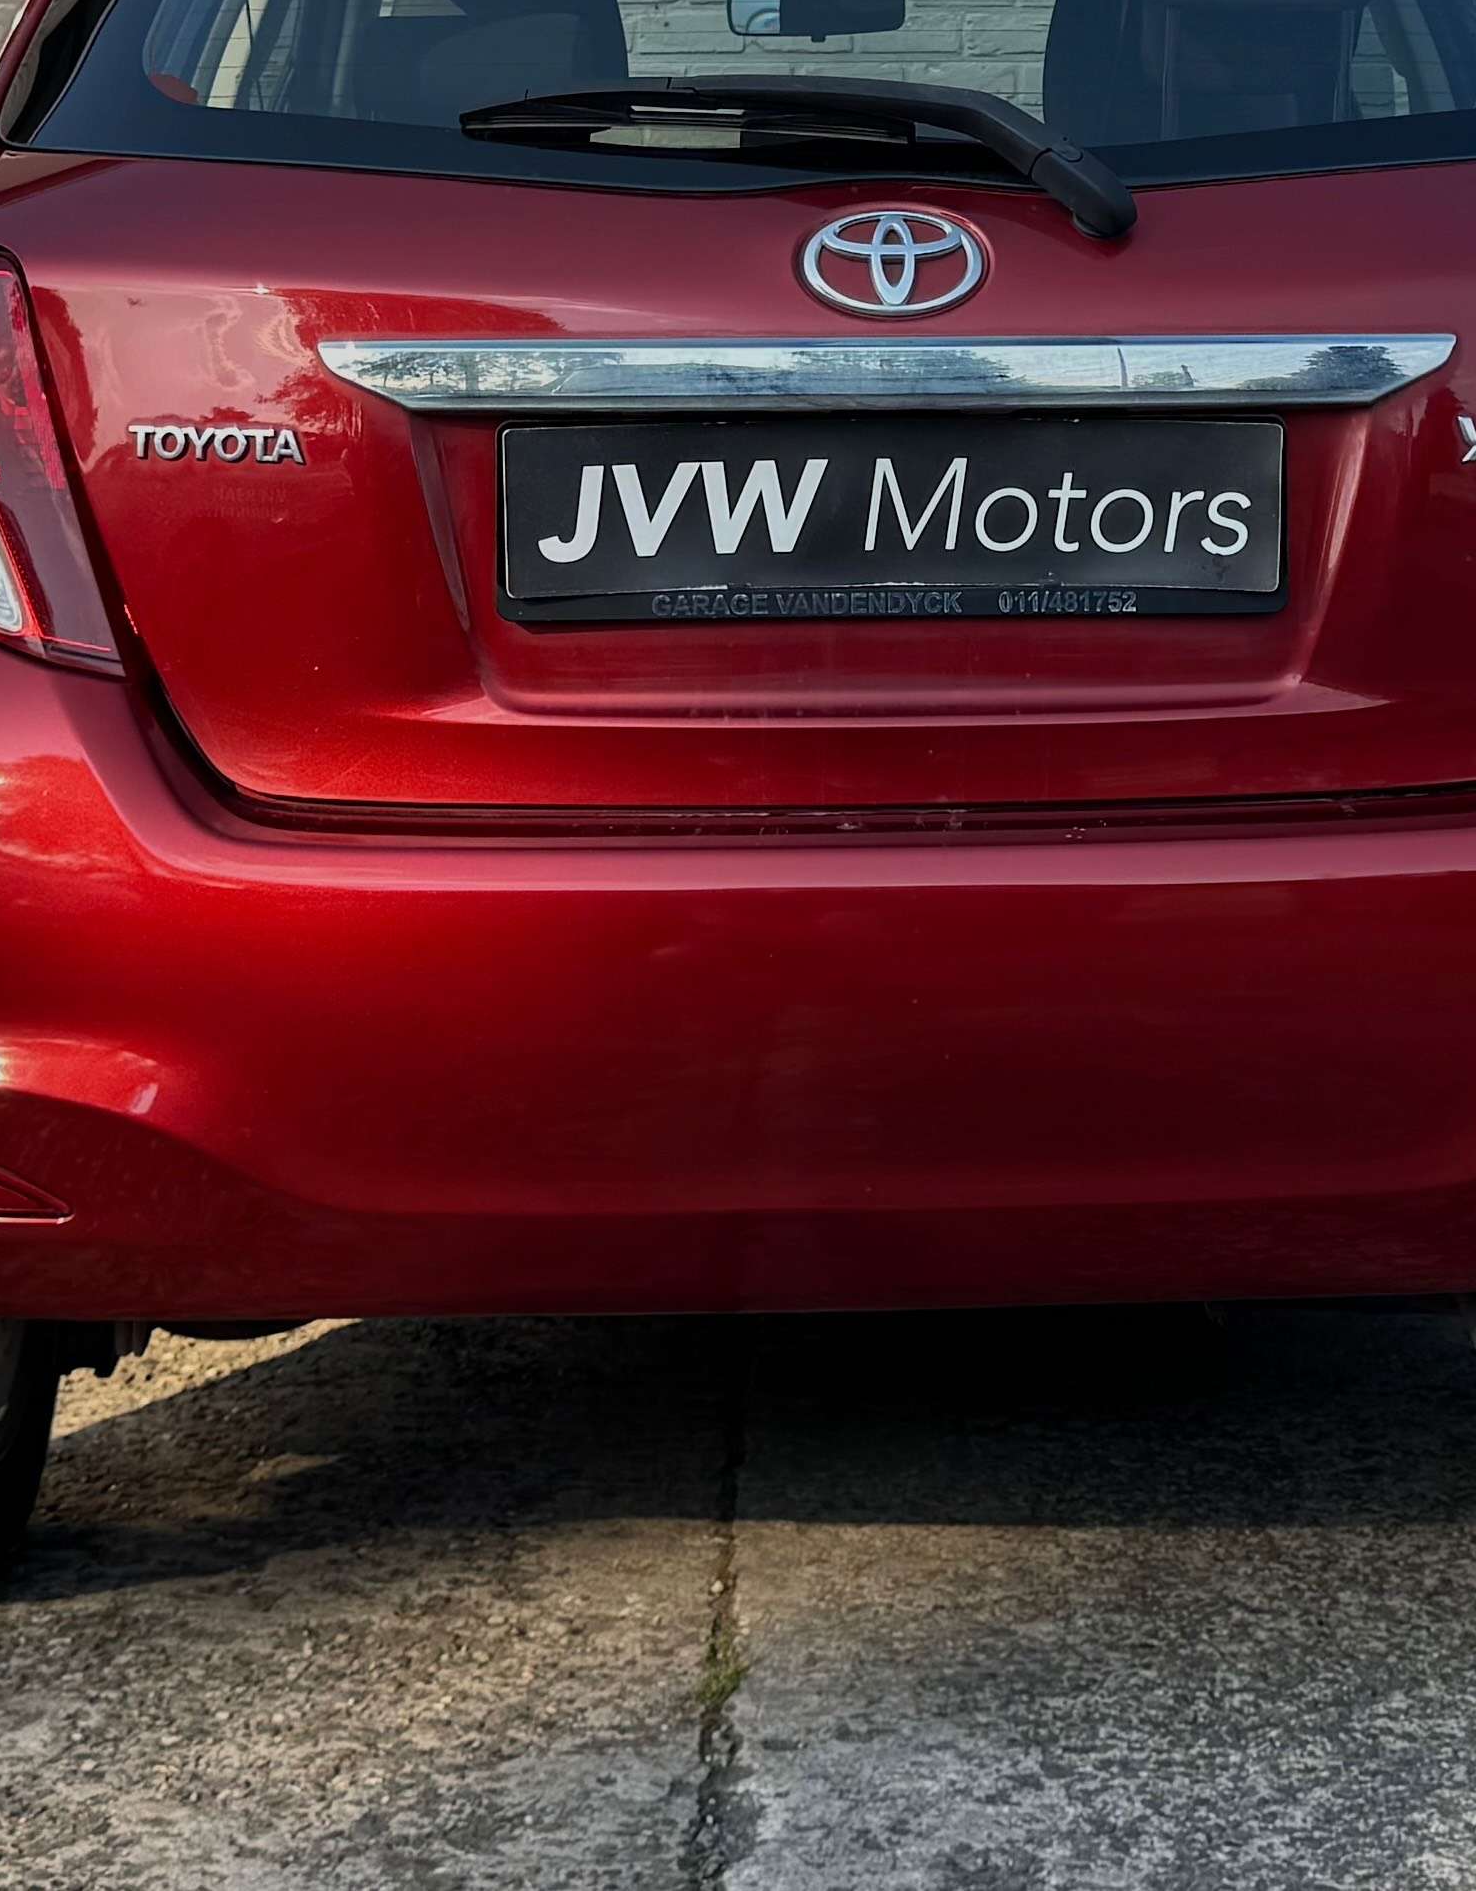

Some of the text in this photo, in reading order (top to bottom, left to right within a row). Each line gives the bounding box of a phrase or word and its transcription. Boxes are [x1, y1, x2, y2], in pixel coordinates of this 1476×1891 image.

[128, 424, 304, 464] TOYOTA
[537, 457, 1252, 564] JVW Motors
[651, 591, 1137, 617] GARAGE VANDENDYCK 011/481752
